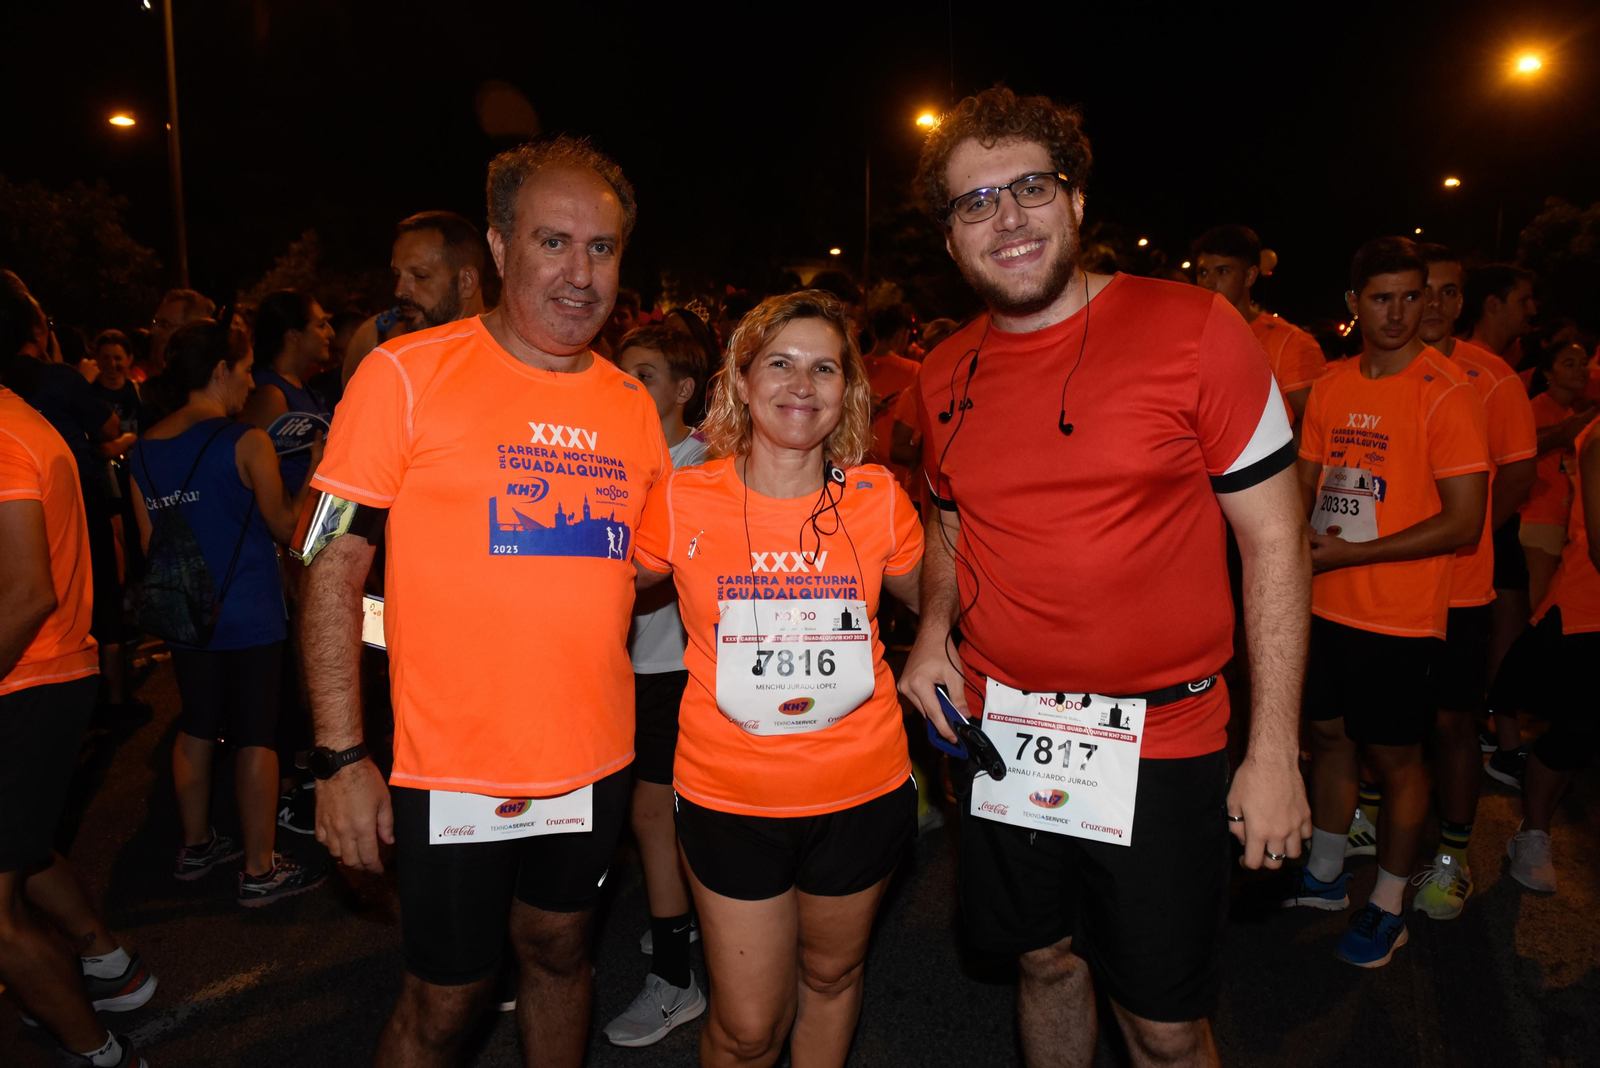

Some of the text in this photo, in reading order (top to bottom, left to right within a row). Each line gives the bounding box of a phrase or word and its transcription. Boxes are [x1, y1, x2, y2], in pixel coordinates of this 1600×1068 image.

[275, 417, 314, 437] life
[528, 421, 598, 451] XXXV
[497, 444, 625, 468] CARRERA NOCTURNA
[509, 456, 628, 482] GUADALQUIVIR
[1320, 494, 1360, 516] 20333
[493, 544, 519, 554] 2023
[750, 550, 828, 573] XXXV
[717, 575, 858, 586] CARRERA NOCTURNA
[717, 585, 858, 600] DEL GUADALQUIVIR
[756, 649, 836, 677] 7816
[816, 682, 837, 690] LOPEZ
[1004, 715, 1026, 724] CARRERA
[1026, 719, 1055, 729] NOCTURNA
[1056, 723, 1066, 731] DEL
[1066, 725, 1109, 737] GUADALQUIVIR
[1015, 732, 1099, 771] 7817
[1007, 766, 1098, 788] ARNAU FAJARDO JURADO
[546, 816, 585, 827] Cruzcampo
[1080, 820, 1123, 836] Cruzcampo
